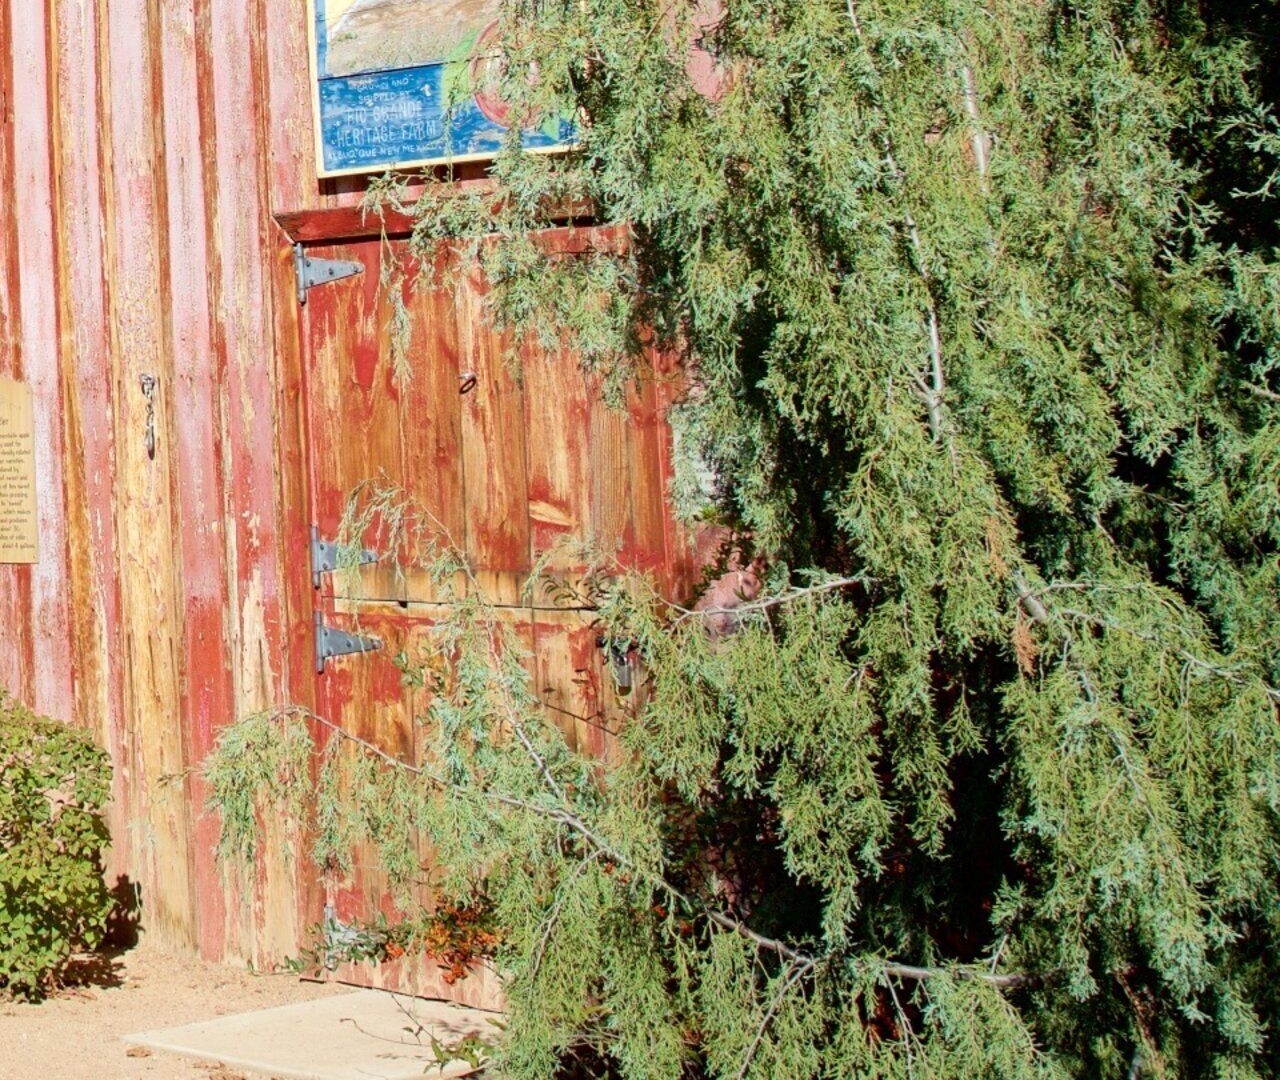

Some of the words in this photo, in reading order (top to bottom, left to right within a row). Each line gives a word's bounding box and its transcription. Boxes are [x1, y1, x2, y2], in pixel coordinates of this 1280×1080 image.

[372, 101, 423, 123] GRANDE
[336, 124, 396, 148] HERITAGE
[401, 119, 436, 141] FARM
